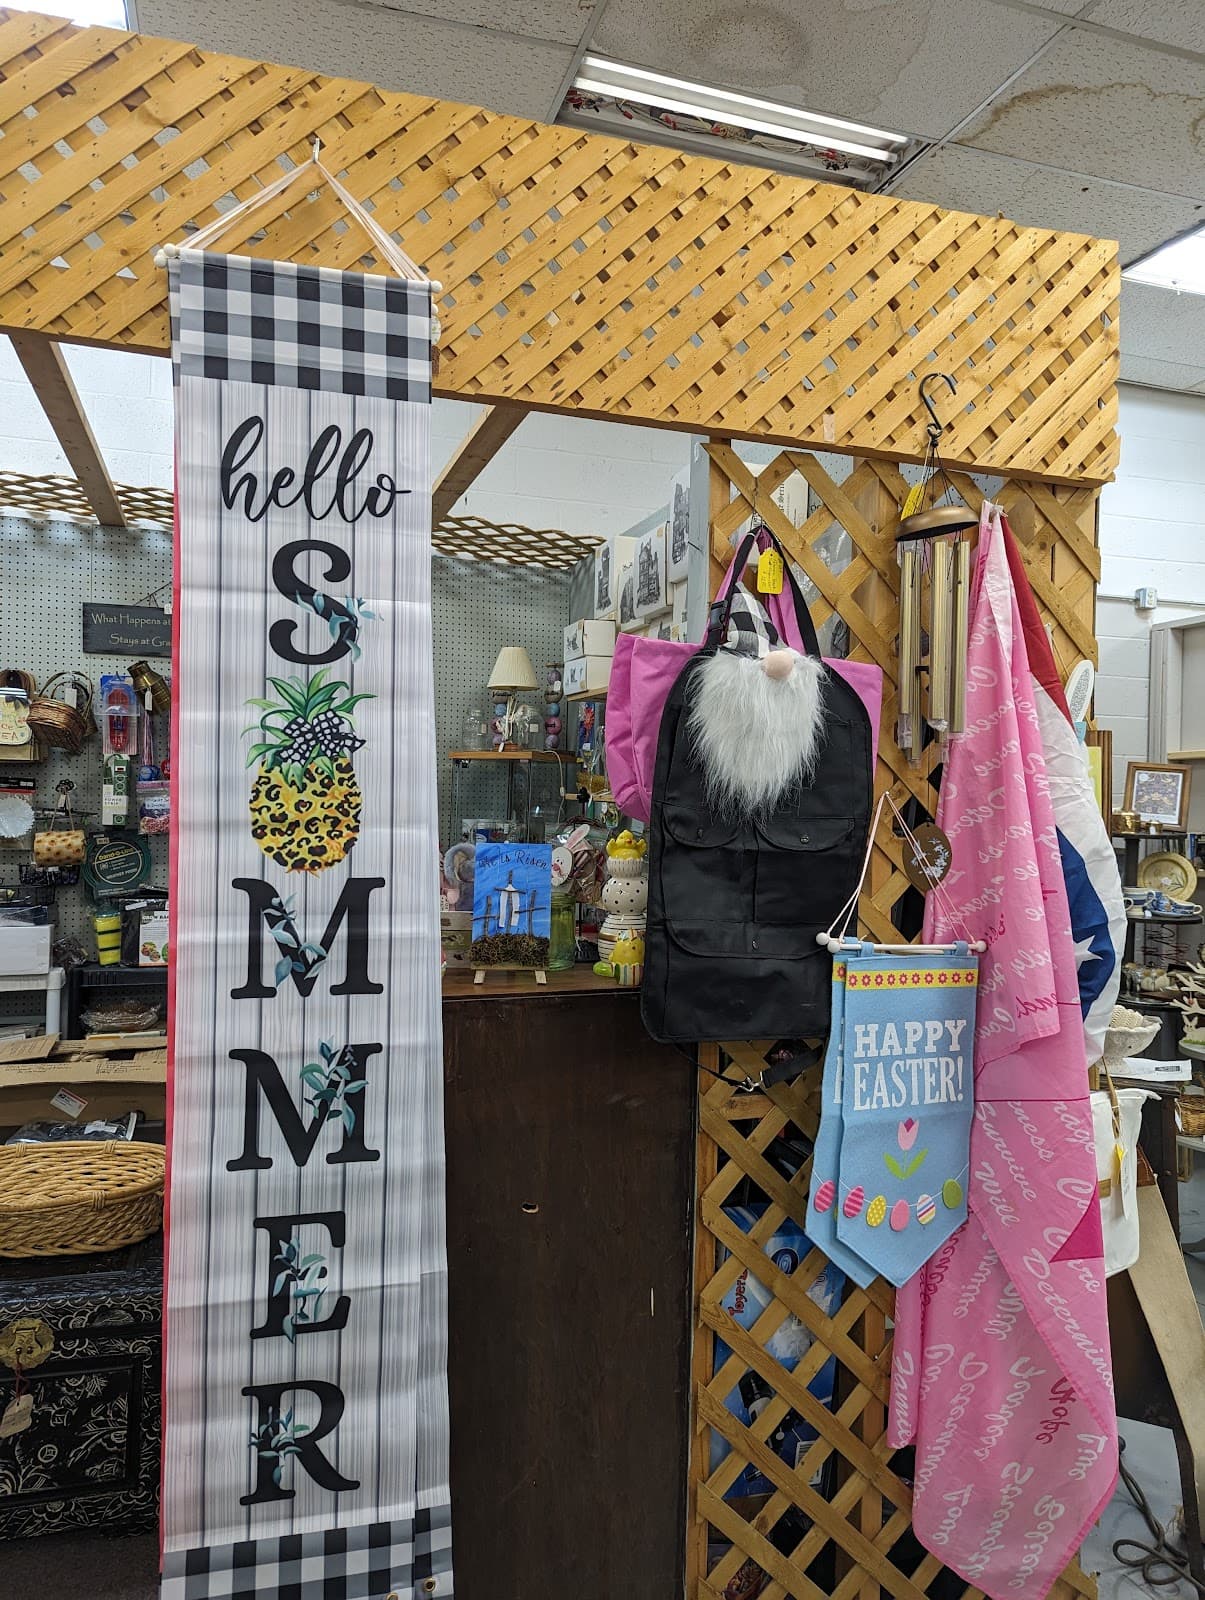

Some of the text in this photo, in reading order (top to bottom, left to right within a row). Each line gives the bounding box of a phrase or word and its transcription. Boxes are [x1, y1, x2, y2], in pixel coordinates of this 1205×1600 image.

[221, 415, 412, 523] hello
[91, 612, 118, 625] What
[119, 613, 161, 628] Happens
[109, 632, 139, 647] Stays
[141, 637, 149, 645] at
[500, 853, 511, 864] is
[514, 849, 548, 870] Risen
[853, 1018, 968, 1058] HAPPY
[853, 1056, 965, 1112] EASTER!
[975, 1101, 1037, 1202] Survive
[975, 1161, 1020, 1227] Will
